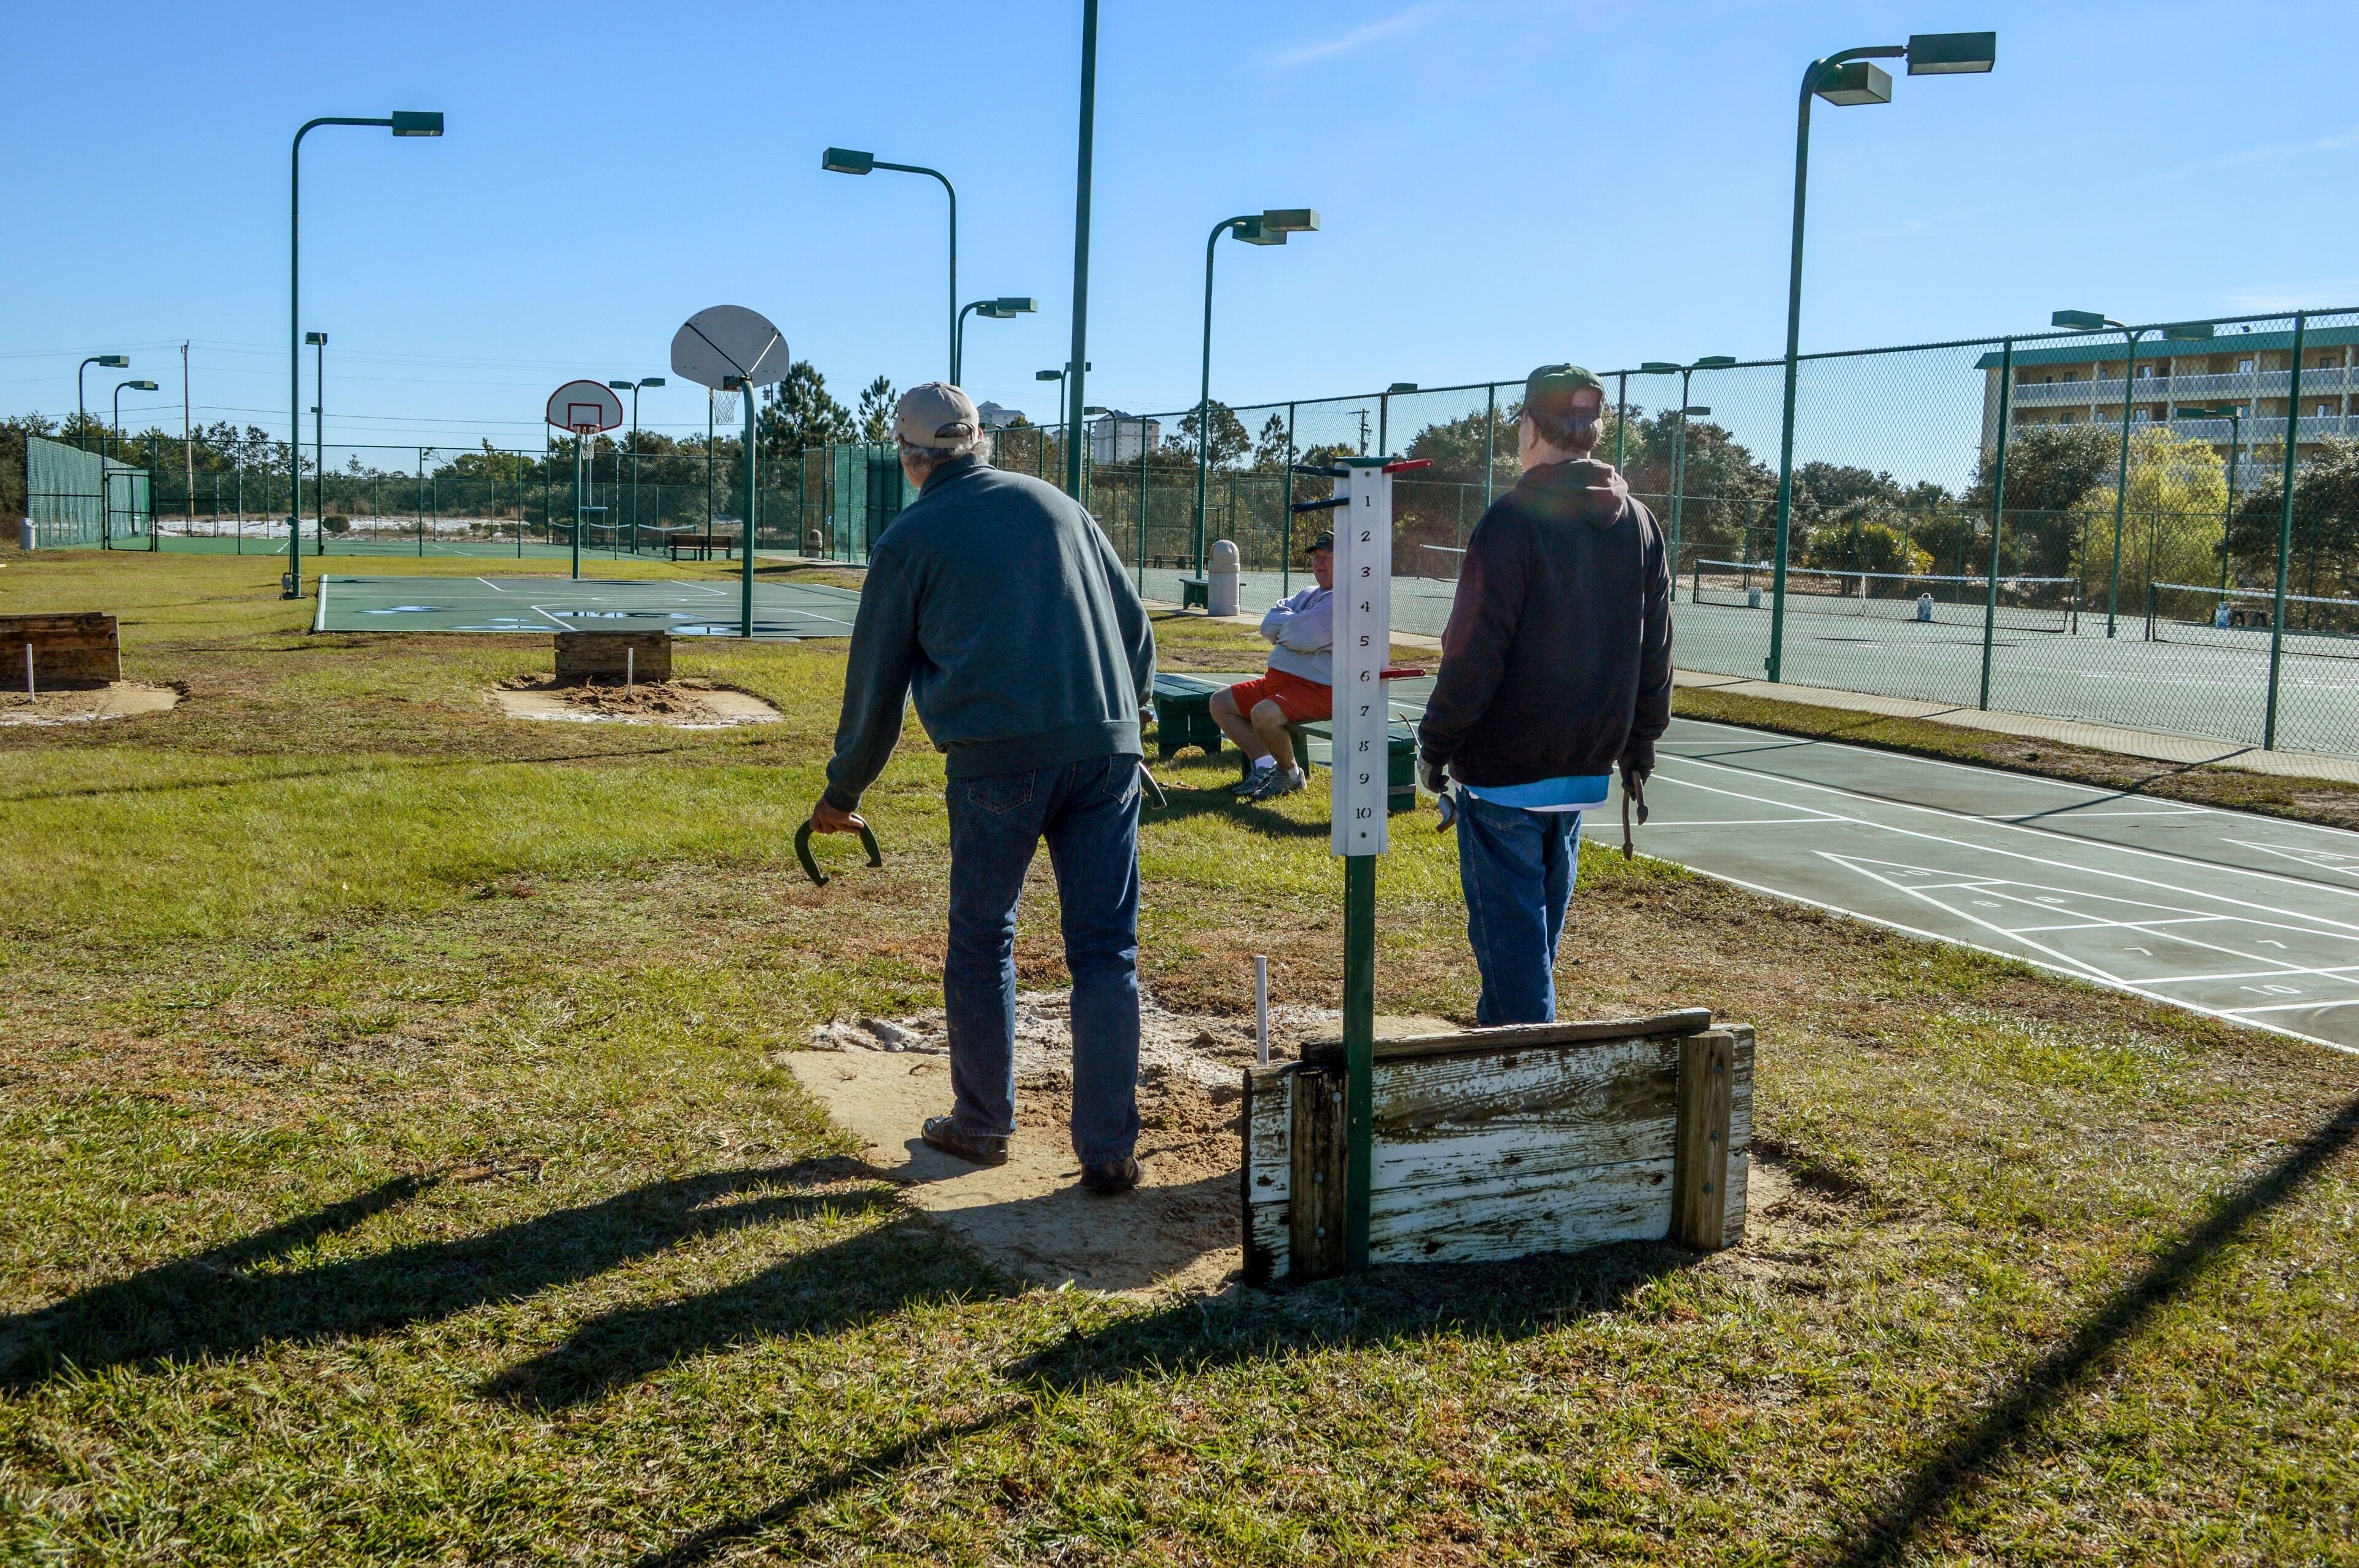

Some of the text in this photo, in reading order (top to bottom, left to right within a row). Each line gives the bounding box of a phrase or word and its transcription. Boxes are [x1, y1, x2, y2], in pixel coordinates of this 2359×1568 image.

[1366, 496, 1370, 506] 1
[1361, 531, 1370, 542] 2
[1361, 567, 1370, 577] 3
[1361, 601, 1370, 612] 4
[1360, 636, 1369, 646] 5
[1360, 671, 1370, 682] 6
[1360, 706, 1369, 716] 7
[1359, 741, 1369, 752] 8
[1359, 773, 1369, 784] 9
[1356, 808, 1371, 818] 10
[2240, 985, 2302, 996] 10
